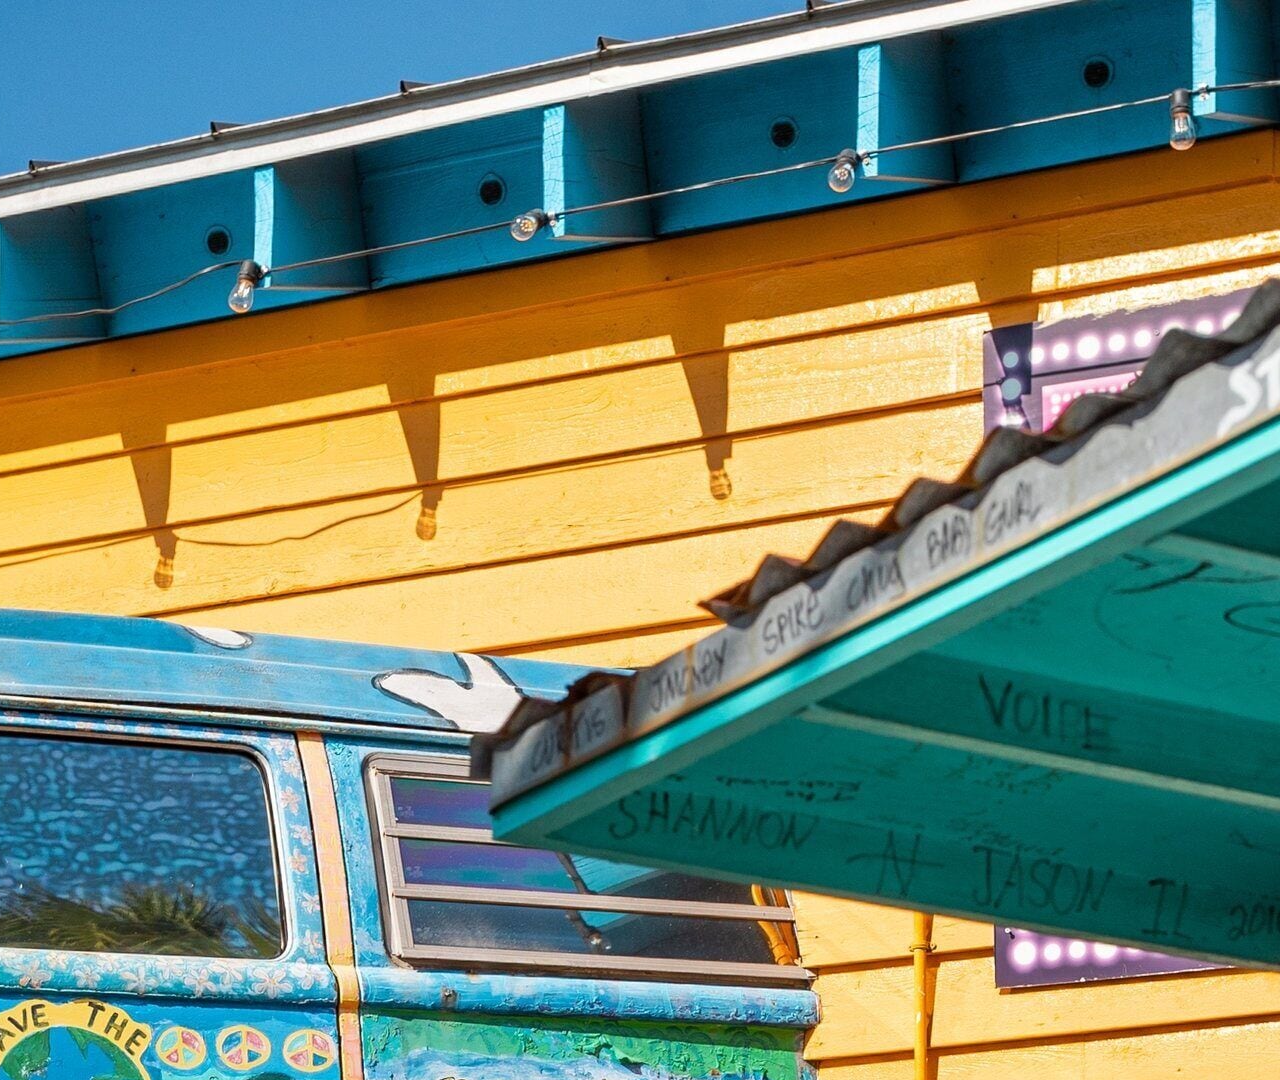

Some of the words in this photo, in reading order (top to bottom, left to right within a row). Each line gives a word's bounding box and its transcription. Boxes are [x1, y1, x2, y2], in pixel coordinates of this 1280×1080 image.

[607, 788, 822, 850] SHANNON
[970, 843, 1114, 916] JASON
[86, 1000, 148, 1057] THE
